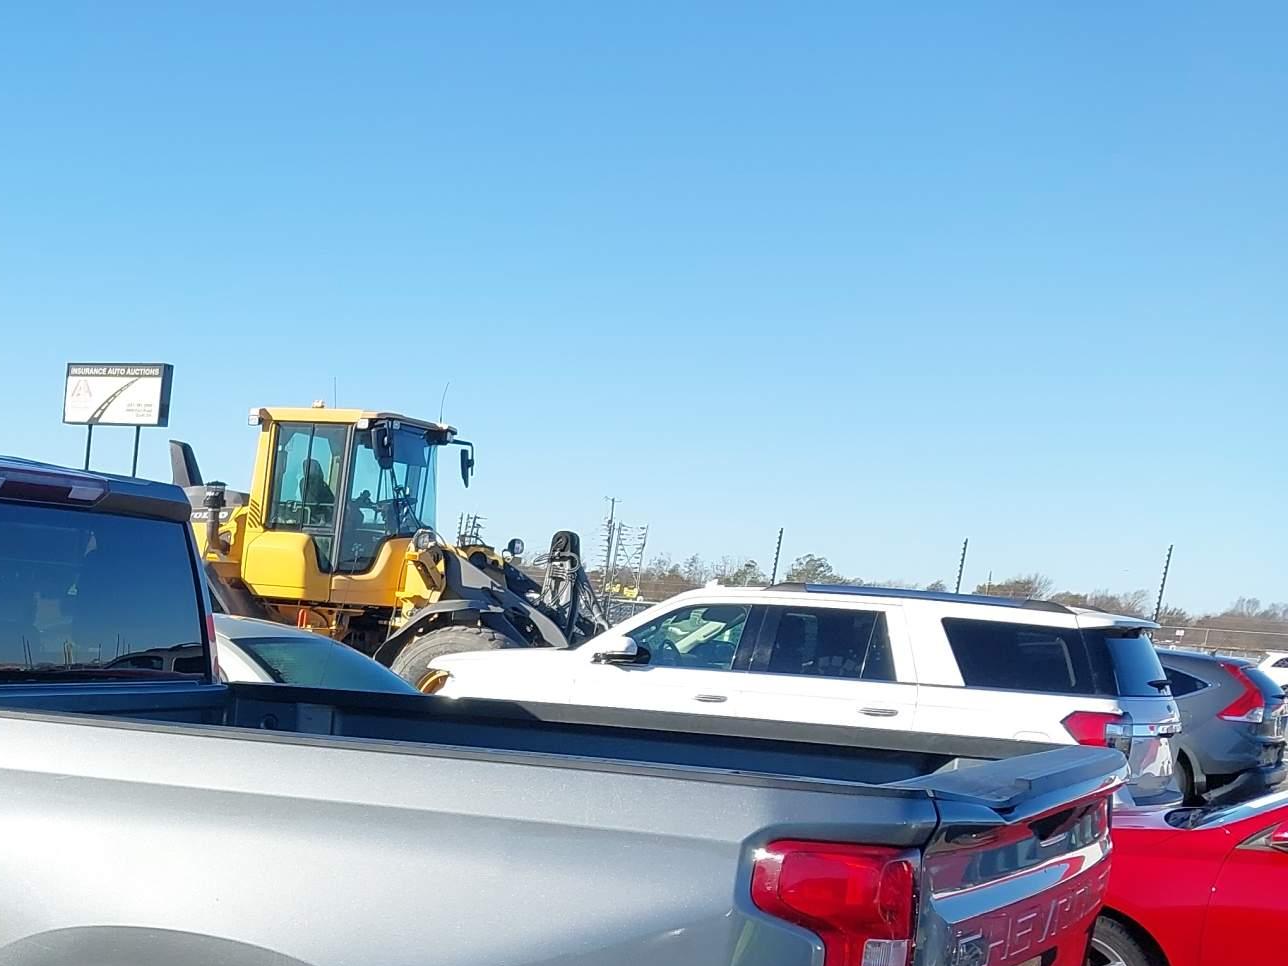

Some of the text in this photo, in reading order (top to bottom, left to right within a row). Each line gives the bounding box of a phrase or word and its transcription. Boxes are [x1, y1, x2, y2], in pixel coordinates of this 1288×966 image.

[70, 367, 160, 377] INSURANCE AUTO AUCTIONS
